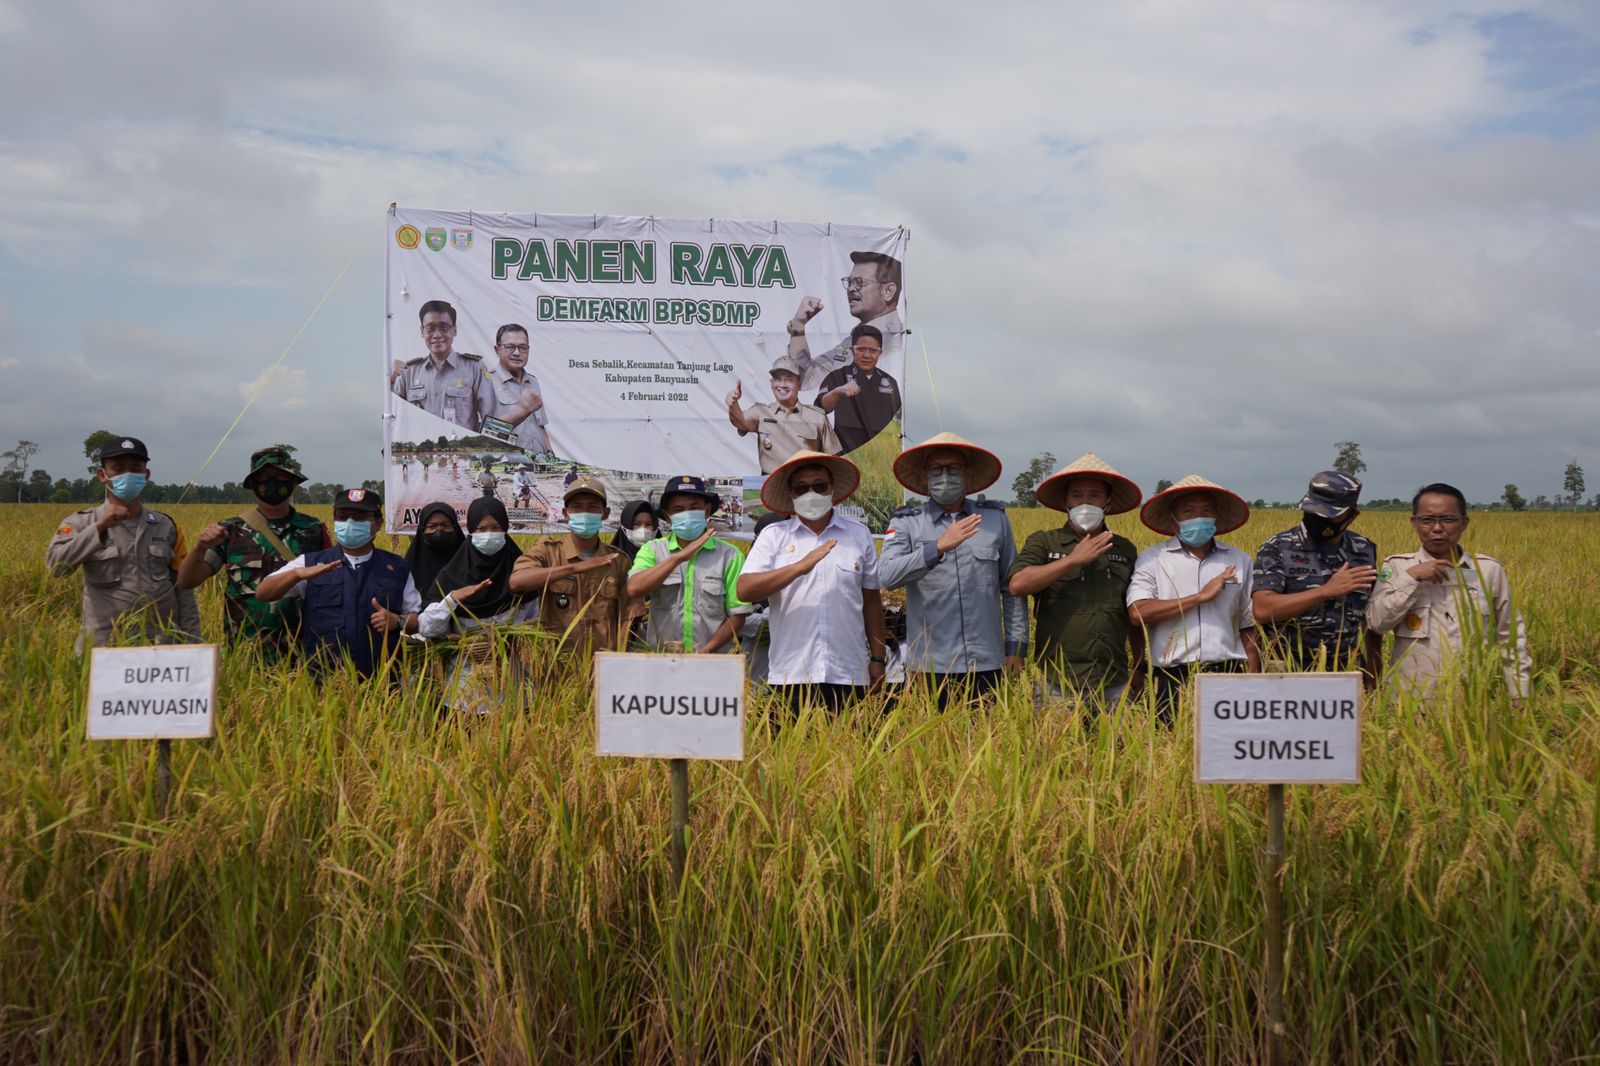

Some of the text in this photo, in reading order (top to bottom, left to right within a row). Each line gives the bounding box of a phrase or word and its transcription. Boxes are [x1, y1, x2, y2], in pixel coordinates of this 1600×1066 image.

[491, 237, 796, 287] PANEN RAYA
[537, 295, 760, 327] DEMFARM BPPSDMP
[568, 359, 590, 369] Desa
[676, 361, 711, 373] Tanjung
[713, 362, 734, 373] Lago
[605, 373, 699, 385] Kabupaten Banyuasin
[620, 392, 689, 402] 4 Februari 2022
[124, 666, 190, 684] BUPATI
[102, 698, 208, 716] BANYUASIN
[612, 694, 738, 717] KAPUSLUH
[1214, 699, 1355, 720] GUBERNUR
[1233, 740, 1335, 760] SUMSEL
